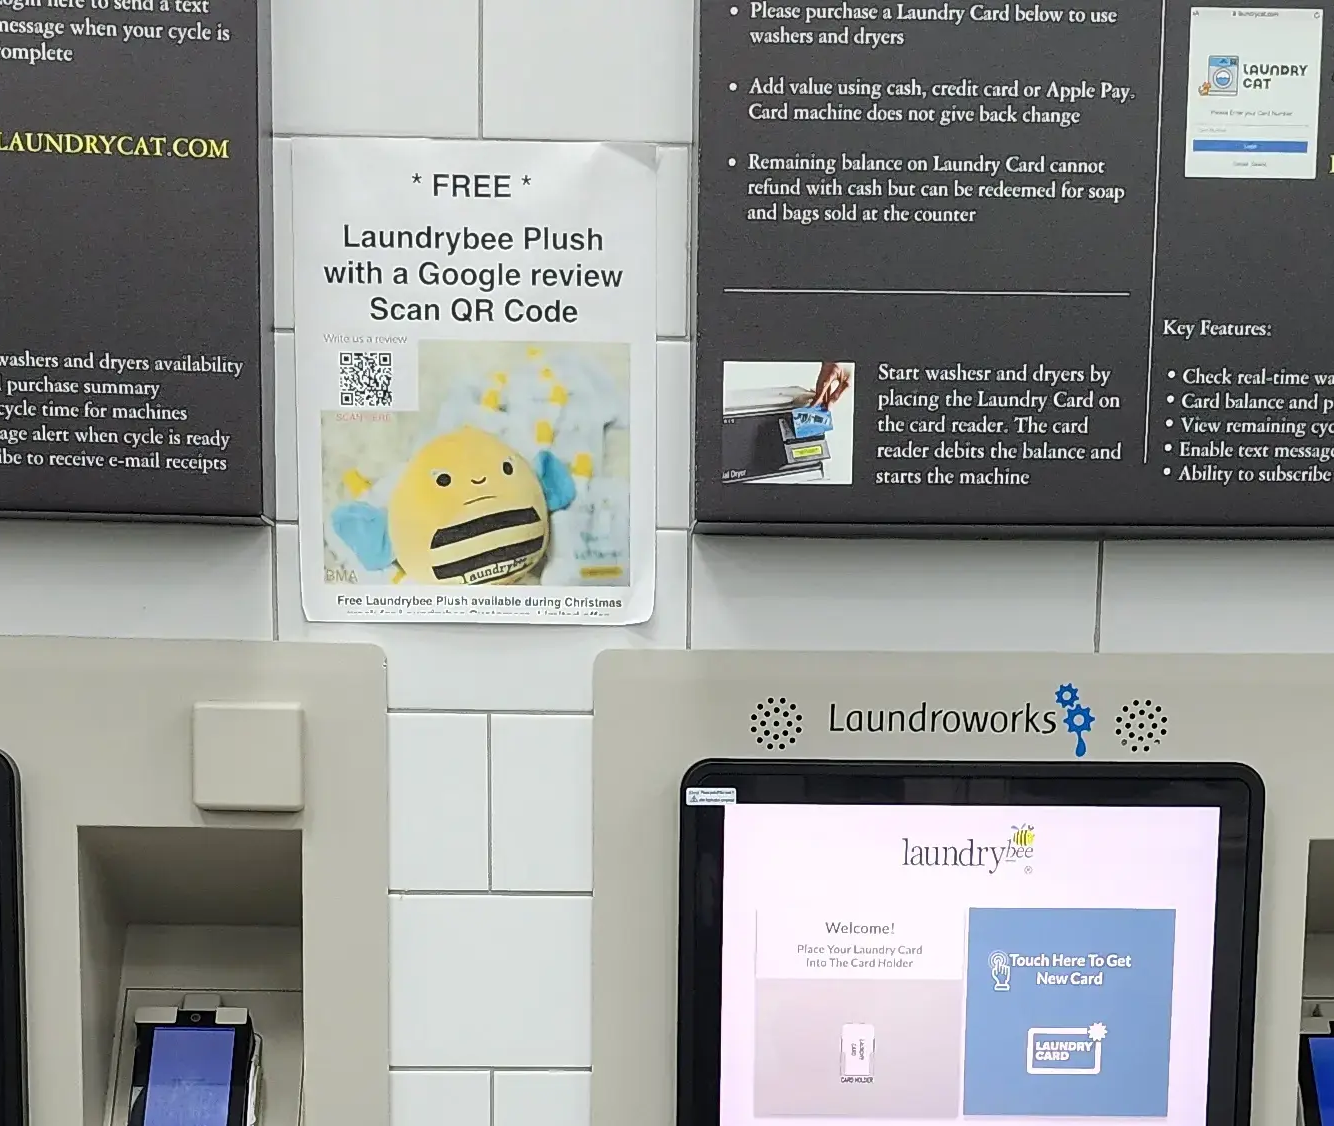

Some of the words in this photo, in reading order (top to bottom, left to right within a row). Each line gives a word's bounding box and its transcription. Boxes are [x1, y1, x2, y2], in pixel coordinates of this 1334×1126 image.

[751, 2, 800, 18] Please
[805, 3, 878, 23] purchase
[883, 8, 892, 19] a
[897, 4, 965, 25] Laundry
[970, 4, 1009, 21] Card
[1015, 4, 1063, 22] below
[1069, 10, 1085, 22] to
[1091, 11, 1117, 23] use
[1243, 64, 1308, 76] LAUNDRY
[1243, 78, 1271, 89] CAT
[433, 174, 511, 198] FREE
[344, 224, 513, 255] Laundrybee
[525, 227, 602, 251] Plush
[324, 261, 382, 284] with
[393, 267, 408, 284] a
[419, 262, 520, 292] Google
[532, 264, 623, 287] review
[370, 297, 439, 320] Scan
[451, 298, 494, 322] QR
[505, 299, 578, 323] Code
[323, 334, 350, 343] Write
[375, 336, 407, 344] review
[64, 352, 94, 368] and
[99, 353, 149, 374] dryers
[155, 355, 243, 377] availability
[1178, 465, 1233, 485] Ability
[1239, 470, 1254, 481] to
[1259, 465, 1331, 481] subscribe
[338, 595, 362, 605] Free
[366, 596, 432, 608] Laundrybee
[437, 596, 468, 605] Plush
[471, 596, 521, 606] available
[525, 597, 561, 609] during
[565, 597, 622, 607] Christmas
[829, 702, 1057, 734] Laundroworks
[1034, 1041, 1093, 1052] LAUNDRY
[1034, 1051, 1070, 1061] CARD
